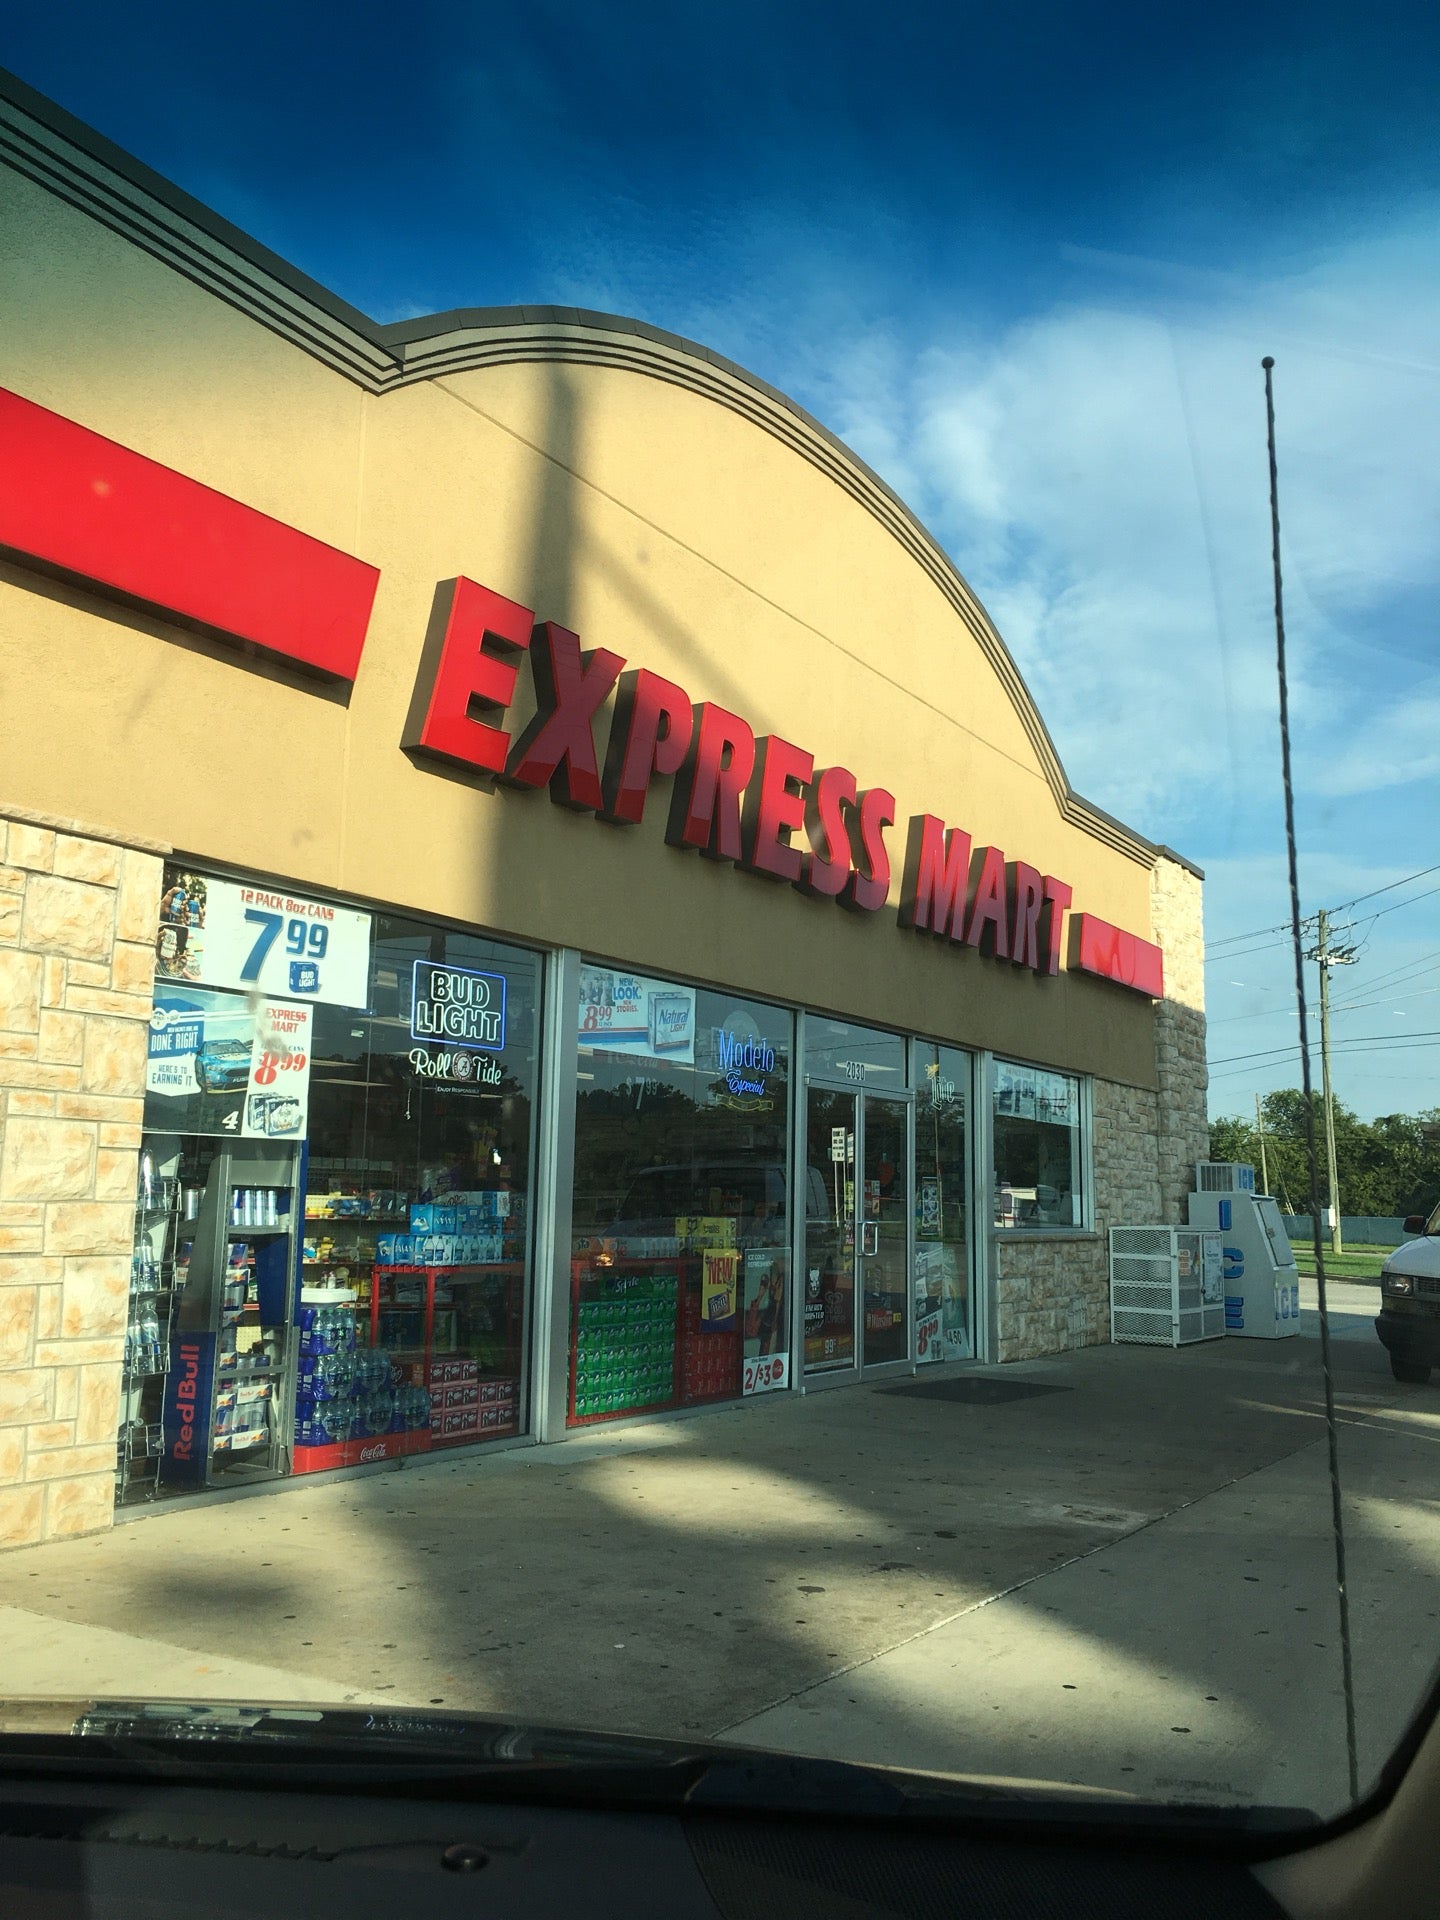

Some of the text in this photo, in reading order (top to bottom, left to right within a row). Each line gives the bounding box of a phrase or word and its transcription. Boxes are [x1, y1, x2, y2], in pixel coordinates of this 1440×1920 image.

[402, 575, 1073, 978] EXPRESS MART
[240, 889, 335, 921] 12 PACK 8oz CANS
[298, 978, 316, 987] LIGHT
[300, 970, 315, 979] BUD
[618, 977, 634, 986] NEW
[430, 970, 490, 1009] BUD
[265, 1007, 307, 1023] EXPRESS
[416, 1000, 501, 1041] LIGHT
[658, 1007, 690, 1026] Natural
[271, 1020, 299, 1034] MART
[151, 1031, 199, 1052] DONE RIGHT
[718, 1029, 775, 1073] Modelo
[409, 1048, 451, 1080] Roll
[472, 1055, 502, 1086] Tide
[846, 1060, 865, 1081] 2030
[152, 1072, 192, 1087] EARNING IT
[725, 1069, 765, 1097] Especial
[221, 1110, 240, 1130] 4
[1238, 1167, 1254, 1190] ICE
[708, 1256, 734, 1285] NEW
[173, 1344, 200, 1461] Red Bull
